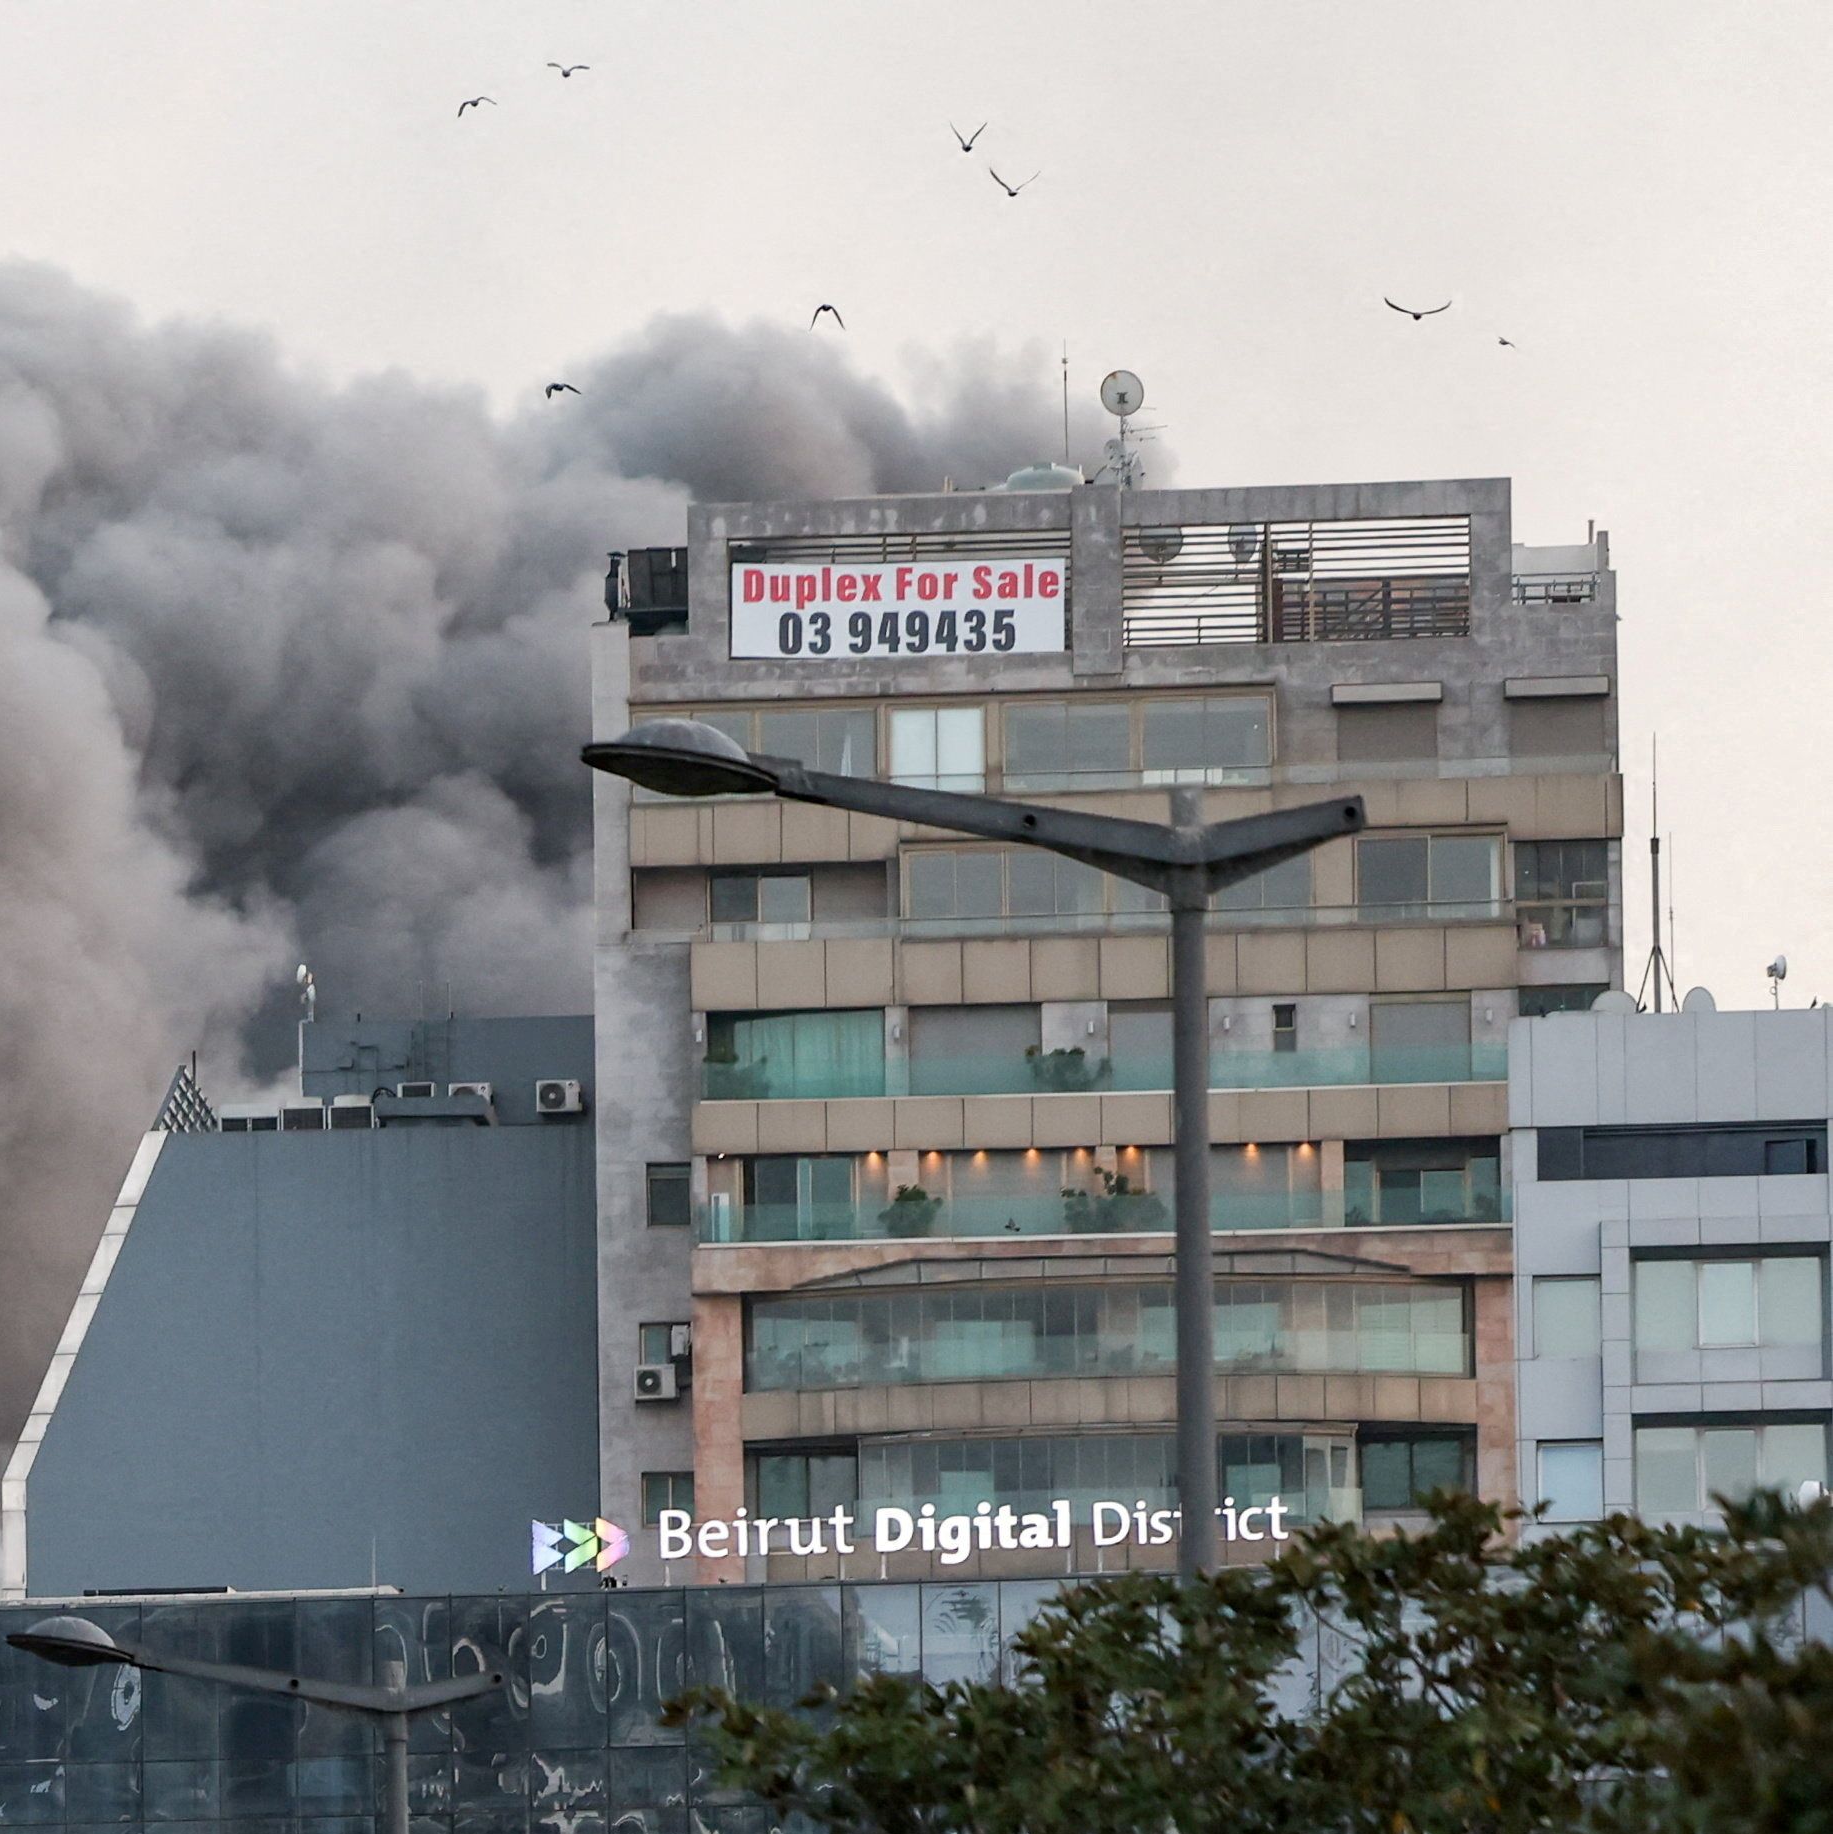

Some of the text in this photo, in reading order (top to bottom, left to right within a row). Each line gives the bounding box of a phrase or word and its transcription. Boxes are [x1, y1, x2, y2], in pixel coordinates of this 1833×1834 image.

[743, 563, 1060, 609] Duplex For Sale
[779, 608, 1016, 655] 03 949435
[658, 1505, 855, 1558] Beirut
[875, 1500, 1072, 1564] Digital
